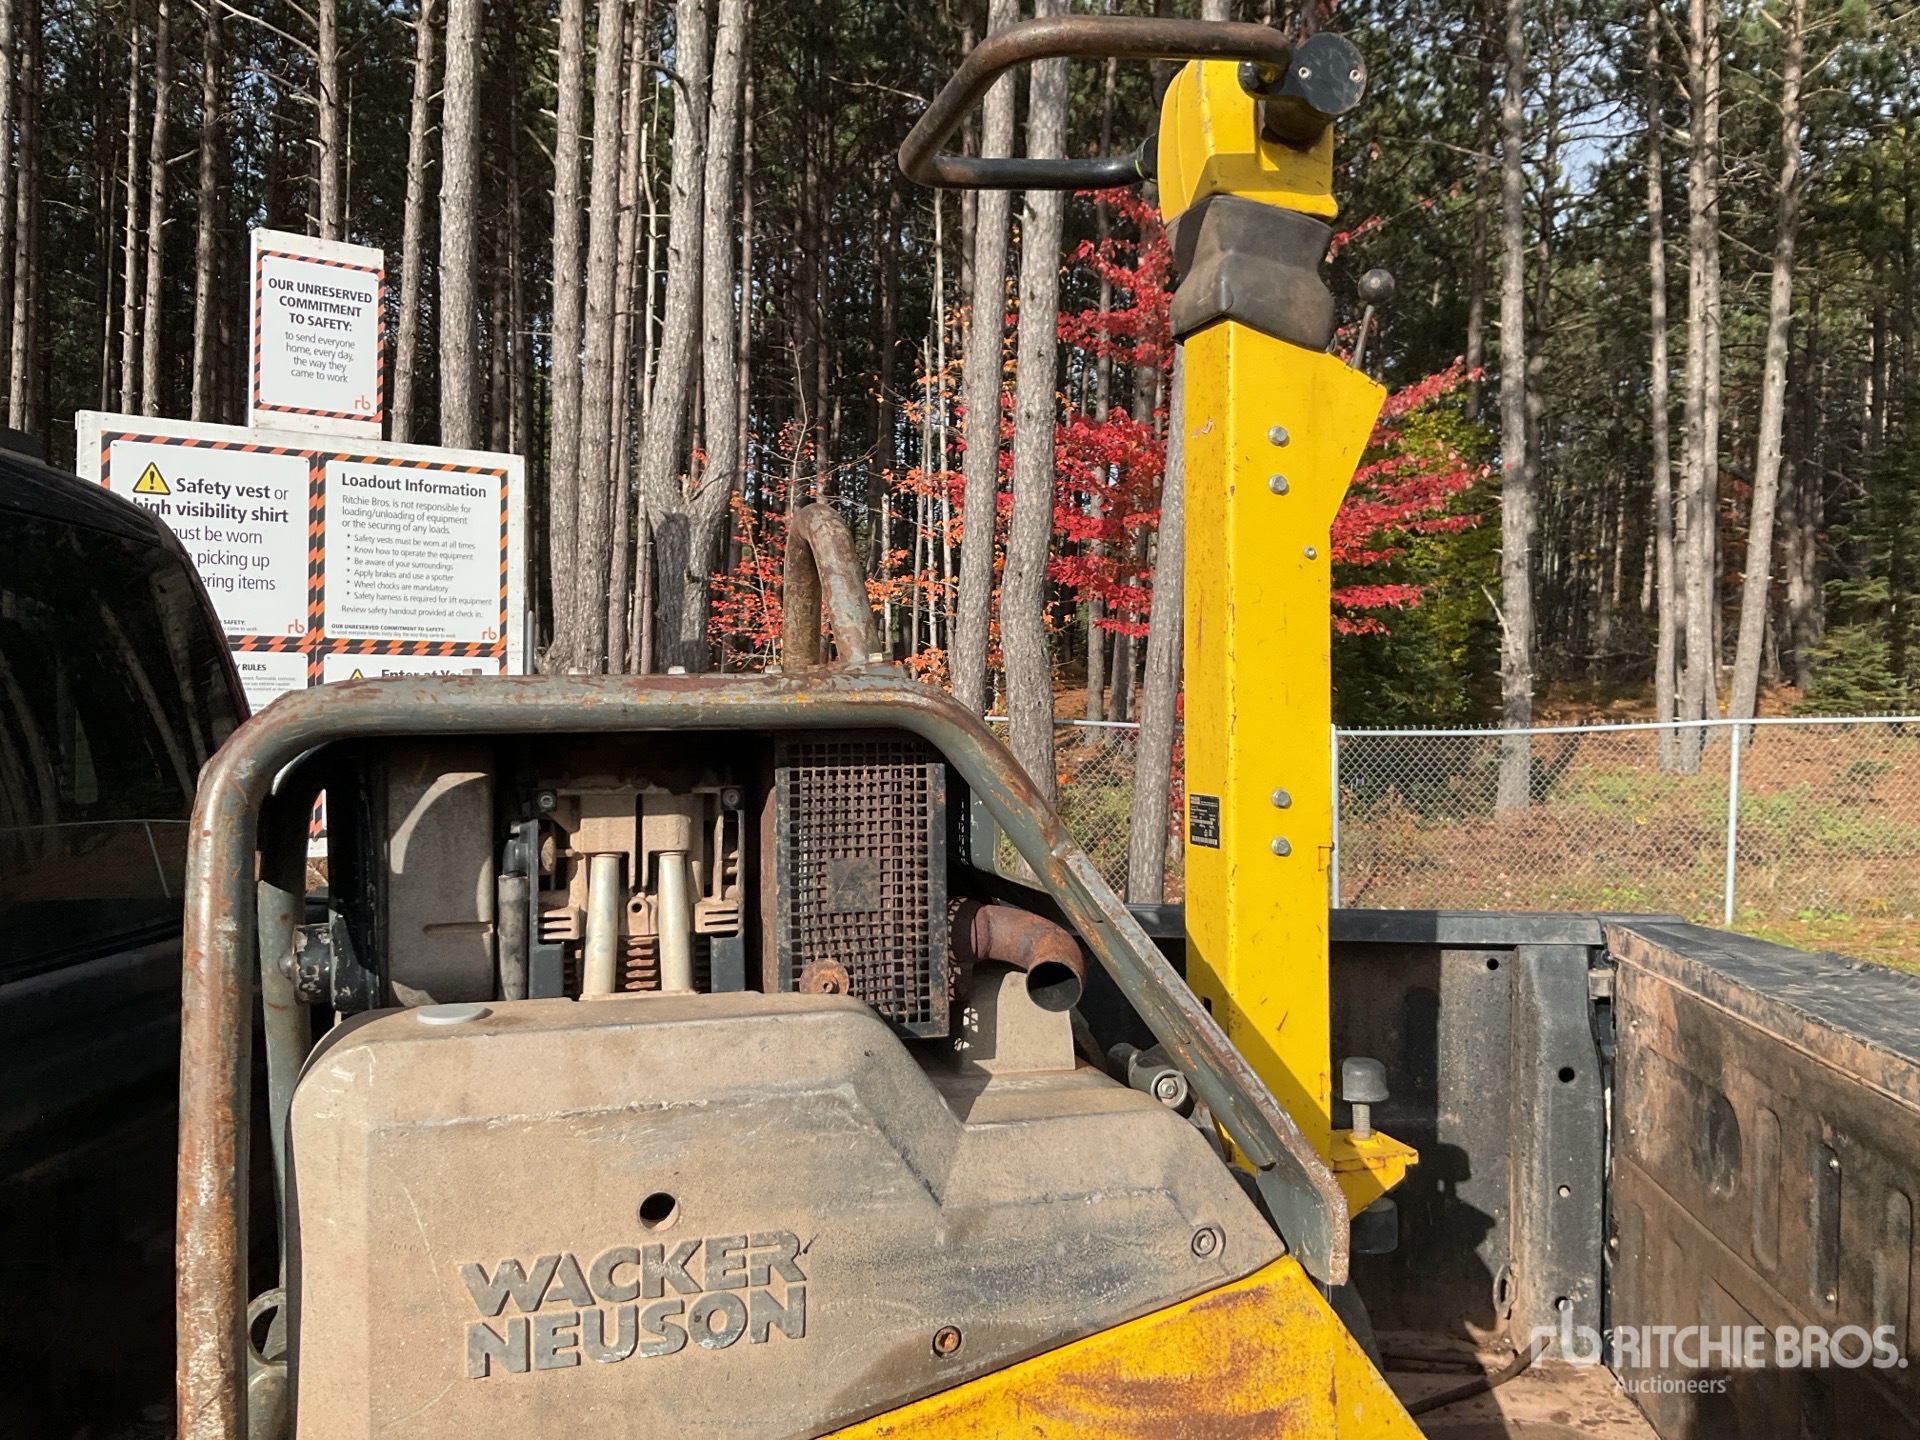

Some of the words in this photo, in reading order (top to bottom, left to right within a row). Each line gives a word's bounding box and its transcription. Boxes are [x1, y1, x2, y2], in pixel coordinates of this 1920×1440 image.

[269, 278, 294, 291] OUR
[297, 282, 372, 303] UNRESERVED
[280, 296, 362, 317] COMMITMENT
[289, 313, 305, 325] TO
[308, 316, 352, 332] SAFETY:
[286, 331, 294, 340] to
[296, 334, 316, 343] send
[318, 337, 355, 349] everyone
[286, 342, 312, 355] home,
[314, 348, 336, 360] every
[338, 350, 354, 362] day,
[294, 356, 307, 366] the
[309, 359, 326, 370] way
[329, 361, 347, 373] they
[291, 369, 314, 378] came
[317, 371, 325, 380] to
[327, 374, 348, 383] work
[355, 395, 371, 410] rb
[176, 478, 231, 499] Safety
[236, 486, 270, 499] vest
[274, 489, 289, 500] or
[342, 473, 401, 491] Loadout
[405, 479, 487, 498] Information
[176, 501, 247, 524] visibility
[251, 507, 289, 523] shirt
[343, 495, 370, 506] Ritchie
[372, 498, 389, 507] Bros.
[393, 499, 399, 508] is
[401, 501, 414, 509] not
[416, 502, 459, 513] responsible
[461, 504, 471, 513] for
[342, 507, 415, 522] loading/unloading
[417, 513, 426, 521] of
[427, 515, 468, 525] equipment
[205, 526, 223, 542] be
[226, 532, 262, 544] worn
[353, 519, 366, 528] the
[368, 522, 401, 533] securing
[403, 523, 411, 531] of
[413, 525, 427, 534] any
[429, 525, 451, 534] loads.
[354, 534, 376, 545] Safety
[413, 538, 421, 546] be
[423, 540, 439, 548] worn
[197, 551, 248, 571] picking
[252, 557, 270, 571] up
[354, 546, 374, 555] Know
[401, 550, 426, 558] operate
[427, 550, 438, 558] the
[440, 552, 473, 560] equipment
[354, 570, 374, 578] Apply
[387, 559, 395, 567] of
[412, 562, 454, 571] surroundings
[200, 574, 234, 592] ering
[238, 575, 276, 591] items
[354, 580, 376, 588] Wheel
[377, 582, 399, 590] chocks
[413, 584, 449, 593] mandatory
[354, 592, 375, 601] Safety
[376, 593, 402, 601] harness
[410, 595, 437, 603] required
[459, 598, 492, 606] equipment
[342, 605, 366, 613] Review
[368, 607, 388, 616] safety
[389, 607, 416, 615] handout
[418, 608, 447, 617] provided
[456, 610, 473, 618] check
[288, 619, 305, 634] rb
[482, 627, 497, 640] rb
[458, 1229, 808, 1317] WACKER
[465, 1285, 807, 1379] NEUSON
